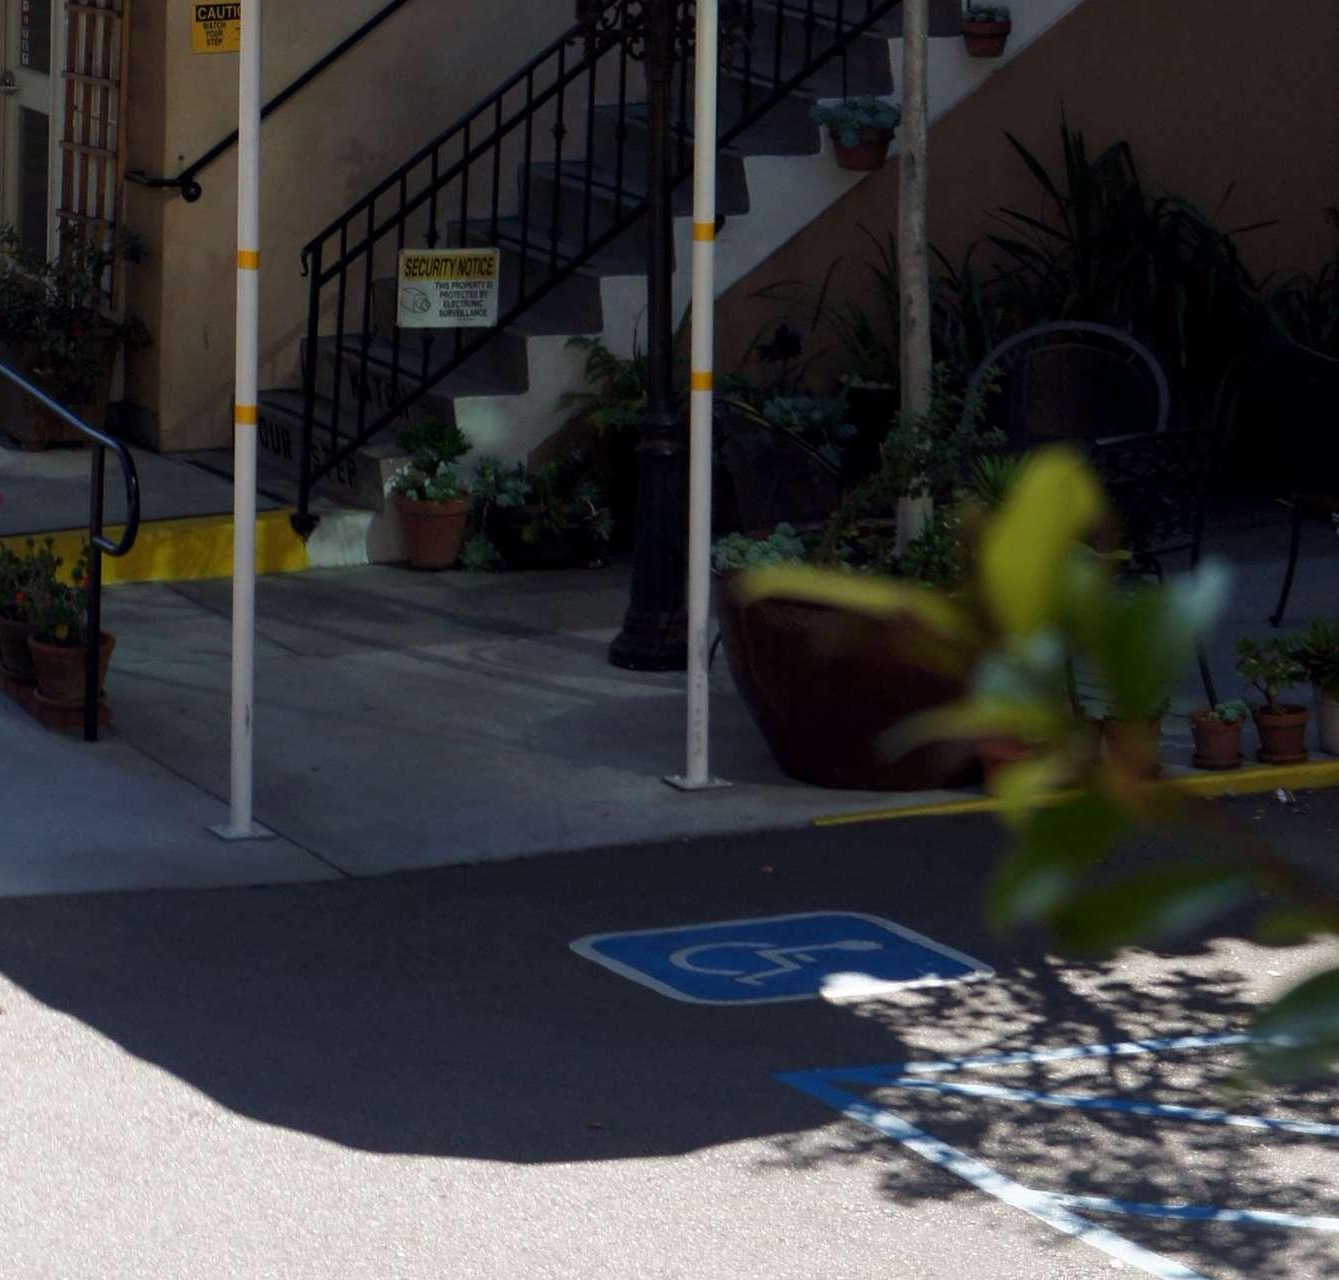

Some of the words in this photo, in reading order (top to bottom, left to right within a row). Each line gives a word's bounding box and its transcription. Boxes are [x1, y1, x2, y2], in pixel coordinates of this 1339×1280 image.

[197, 5, 241, 20] CAUTI
[405, 256, 456, 278] SECURITY
[457, 255, 494, 277] NOTICE
[258, 416, 292, 460] OUR
